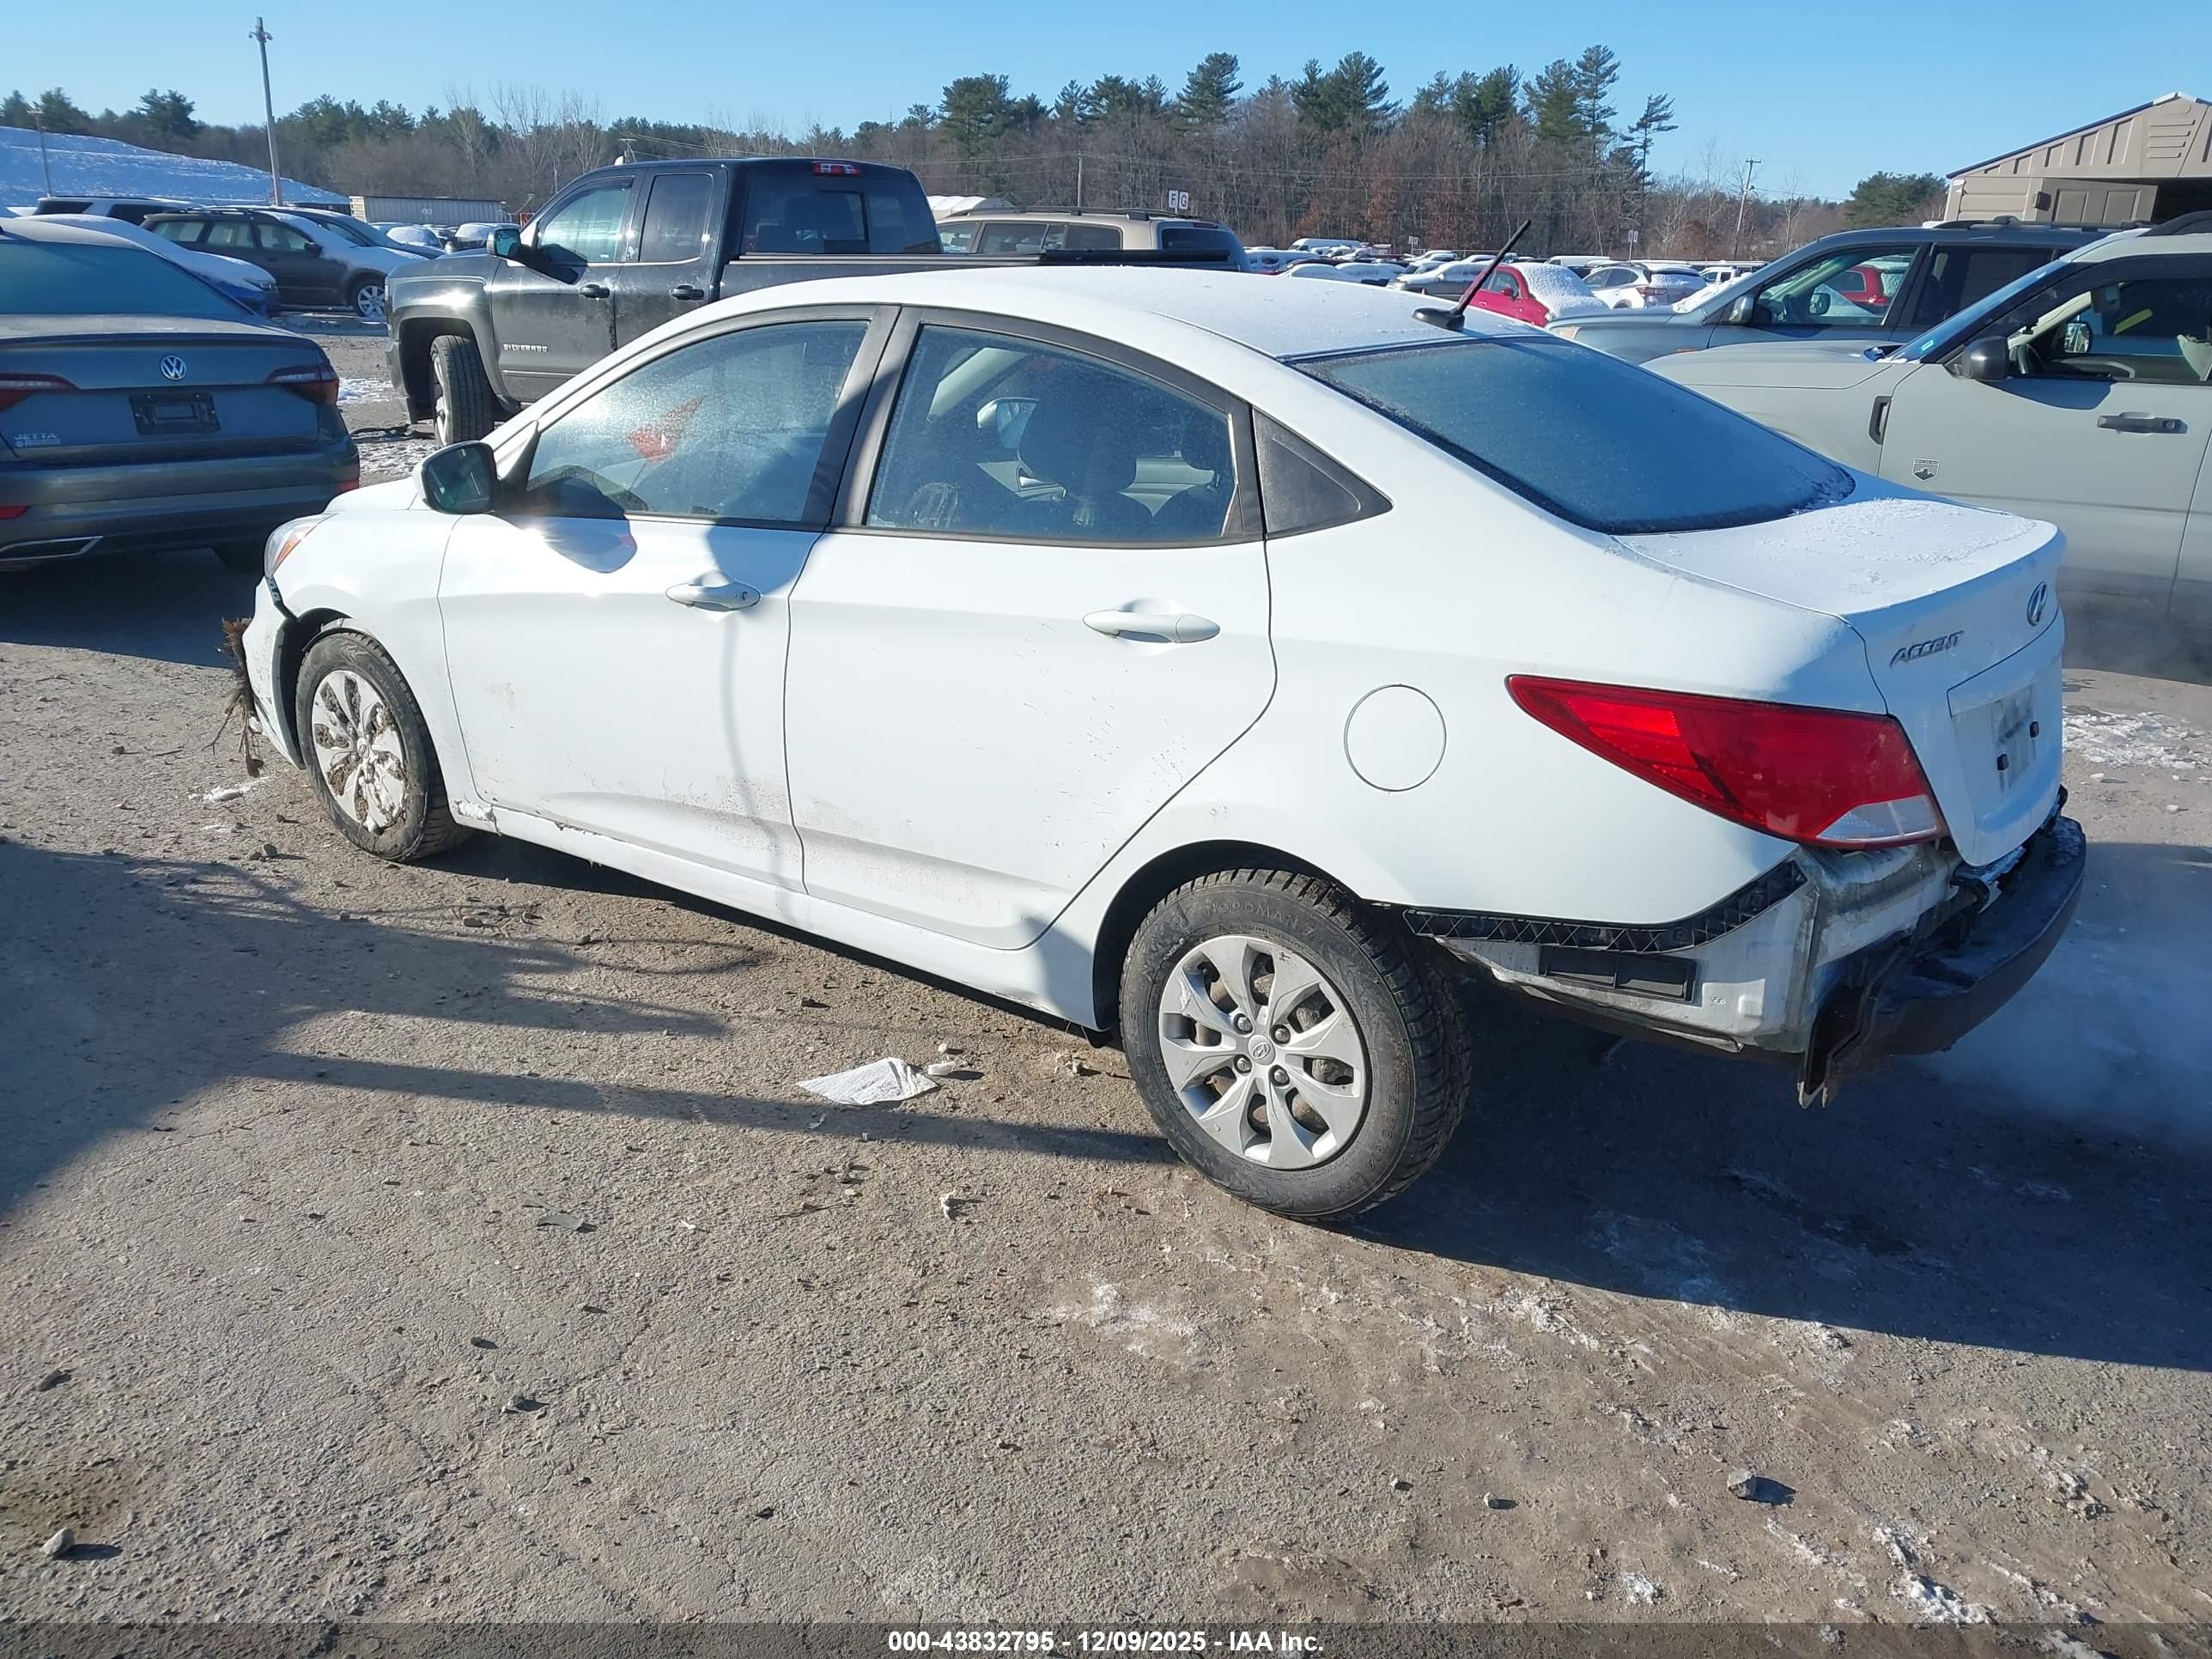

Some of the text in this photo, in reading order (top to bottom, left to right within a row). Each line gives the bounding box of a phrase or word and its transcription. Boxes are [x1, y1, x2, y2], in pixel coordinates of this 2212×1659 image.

[1170, 193, 1176, 205] F
[1182, 194, 1187, 206] G
[503, 343, 547, 352] SILVERADO
[1889, 630, 1964, 666] ACCENT
[1204, 900, 1299, 929] NORDMAN
